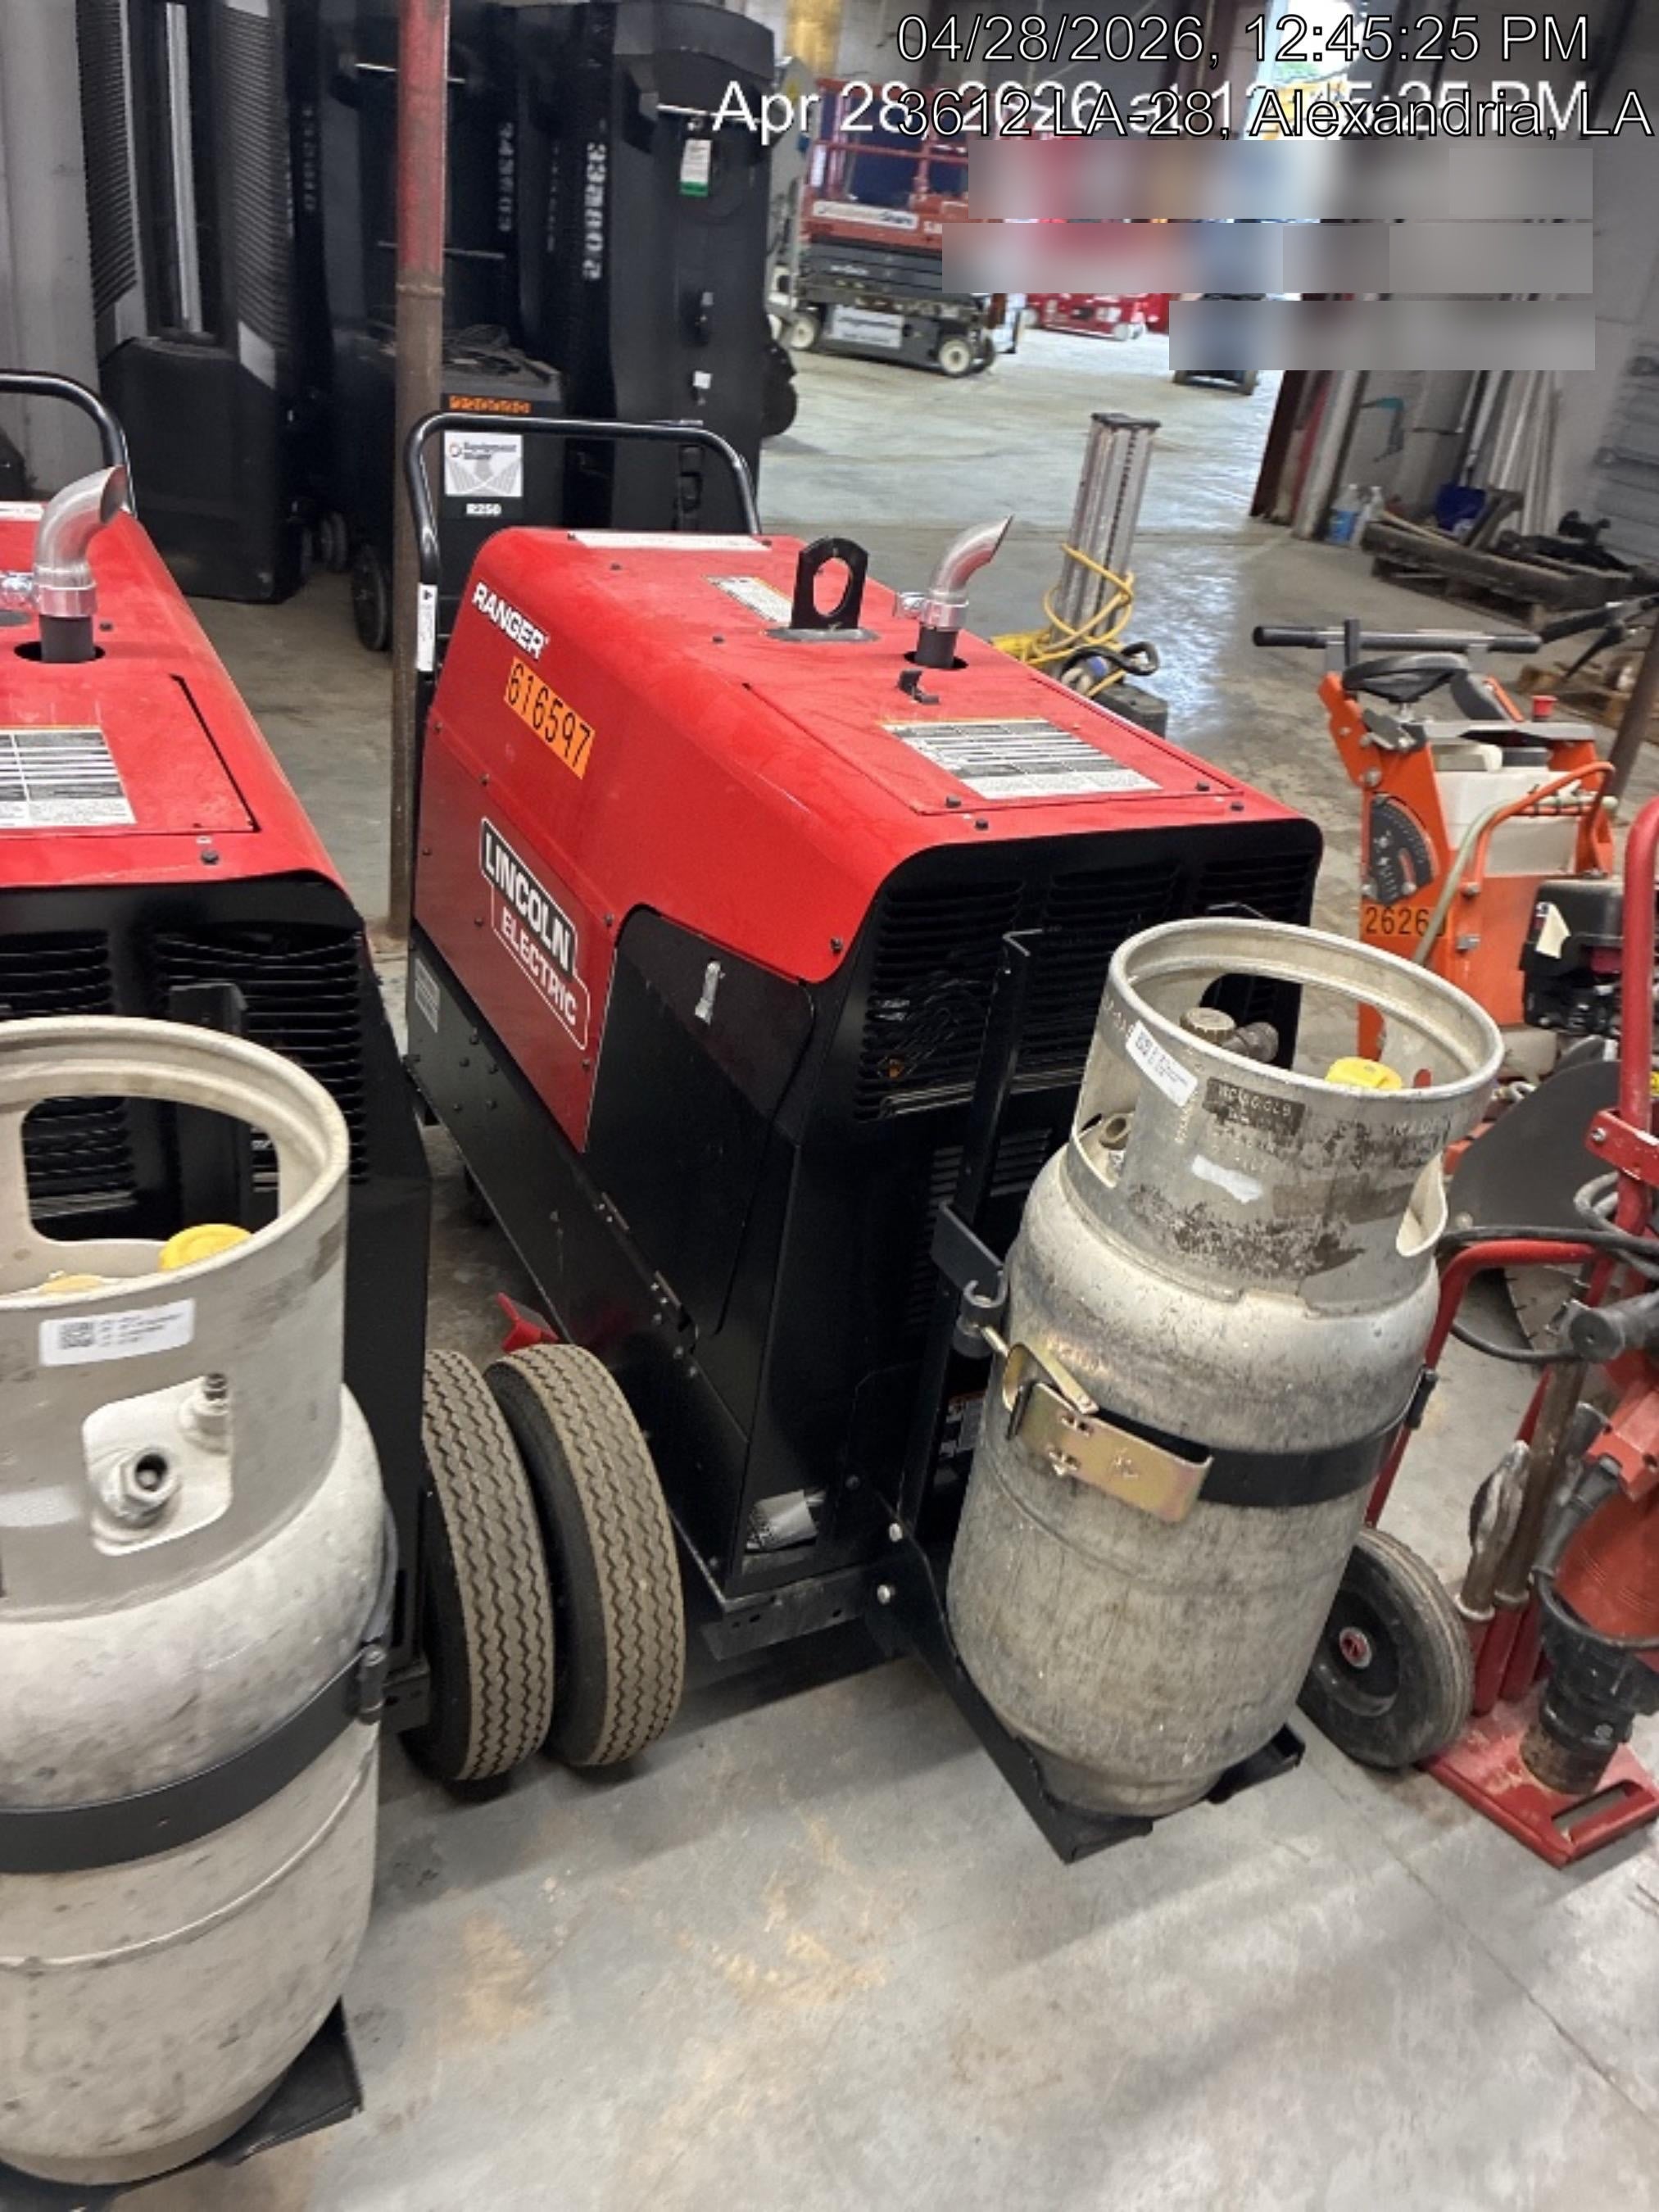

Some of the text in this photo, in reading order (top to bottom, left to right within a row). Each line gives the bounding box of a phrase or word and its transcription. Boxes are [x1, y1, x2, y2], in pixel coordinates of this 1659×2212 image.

[472, 582, 545, 659] RANGER
[508, 662, 591, 768] 616597
[485, 832, 571, 972] LINCOLN
[501, 906, 577, 1026] ELECTRIC
